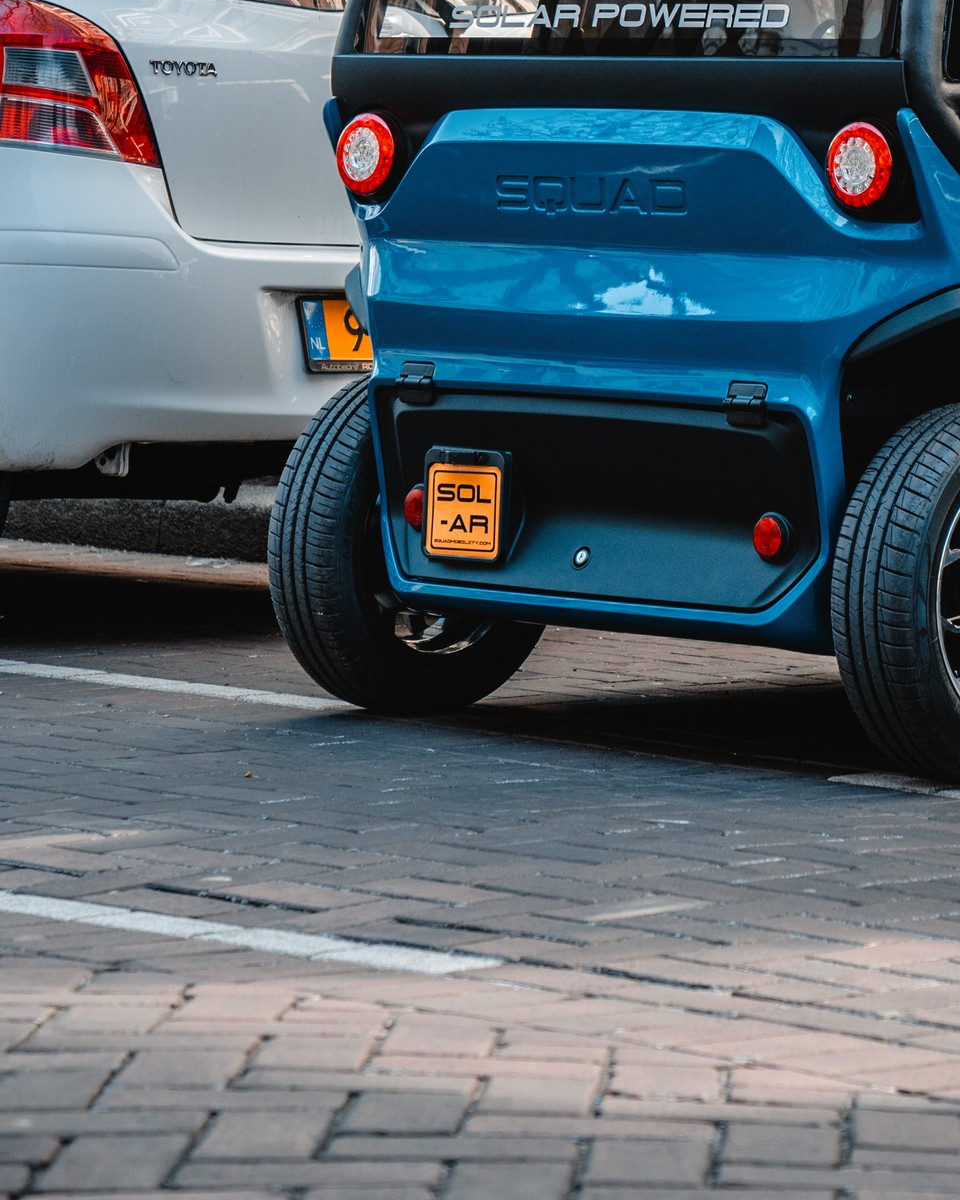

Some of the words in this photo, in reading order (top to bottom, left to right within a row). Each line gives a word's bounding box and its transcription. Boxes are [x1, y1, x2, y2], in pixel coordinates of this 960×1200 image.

[449, 3, 582, 30] SOLAR
[592, 3, 791, 30] POWERED
[149, 59, 218, 77] TOYOTA
[495, 174, 689, 217] SQUAD
[344, 306, 369, 352] 9
[310, 336, 326, 350] NL
[437, 483, 492, 504] SOL
[440, 513, 489, 534] -AR
